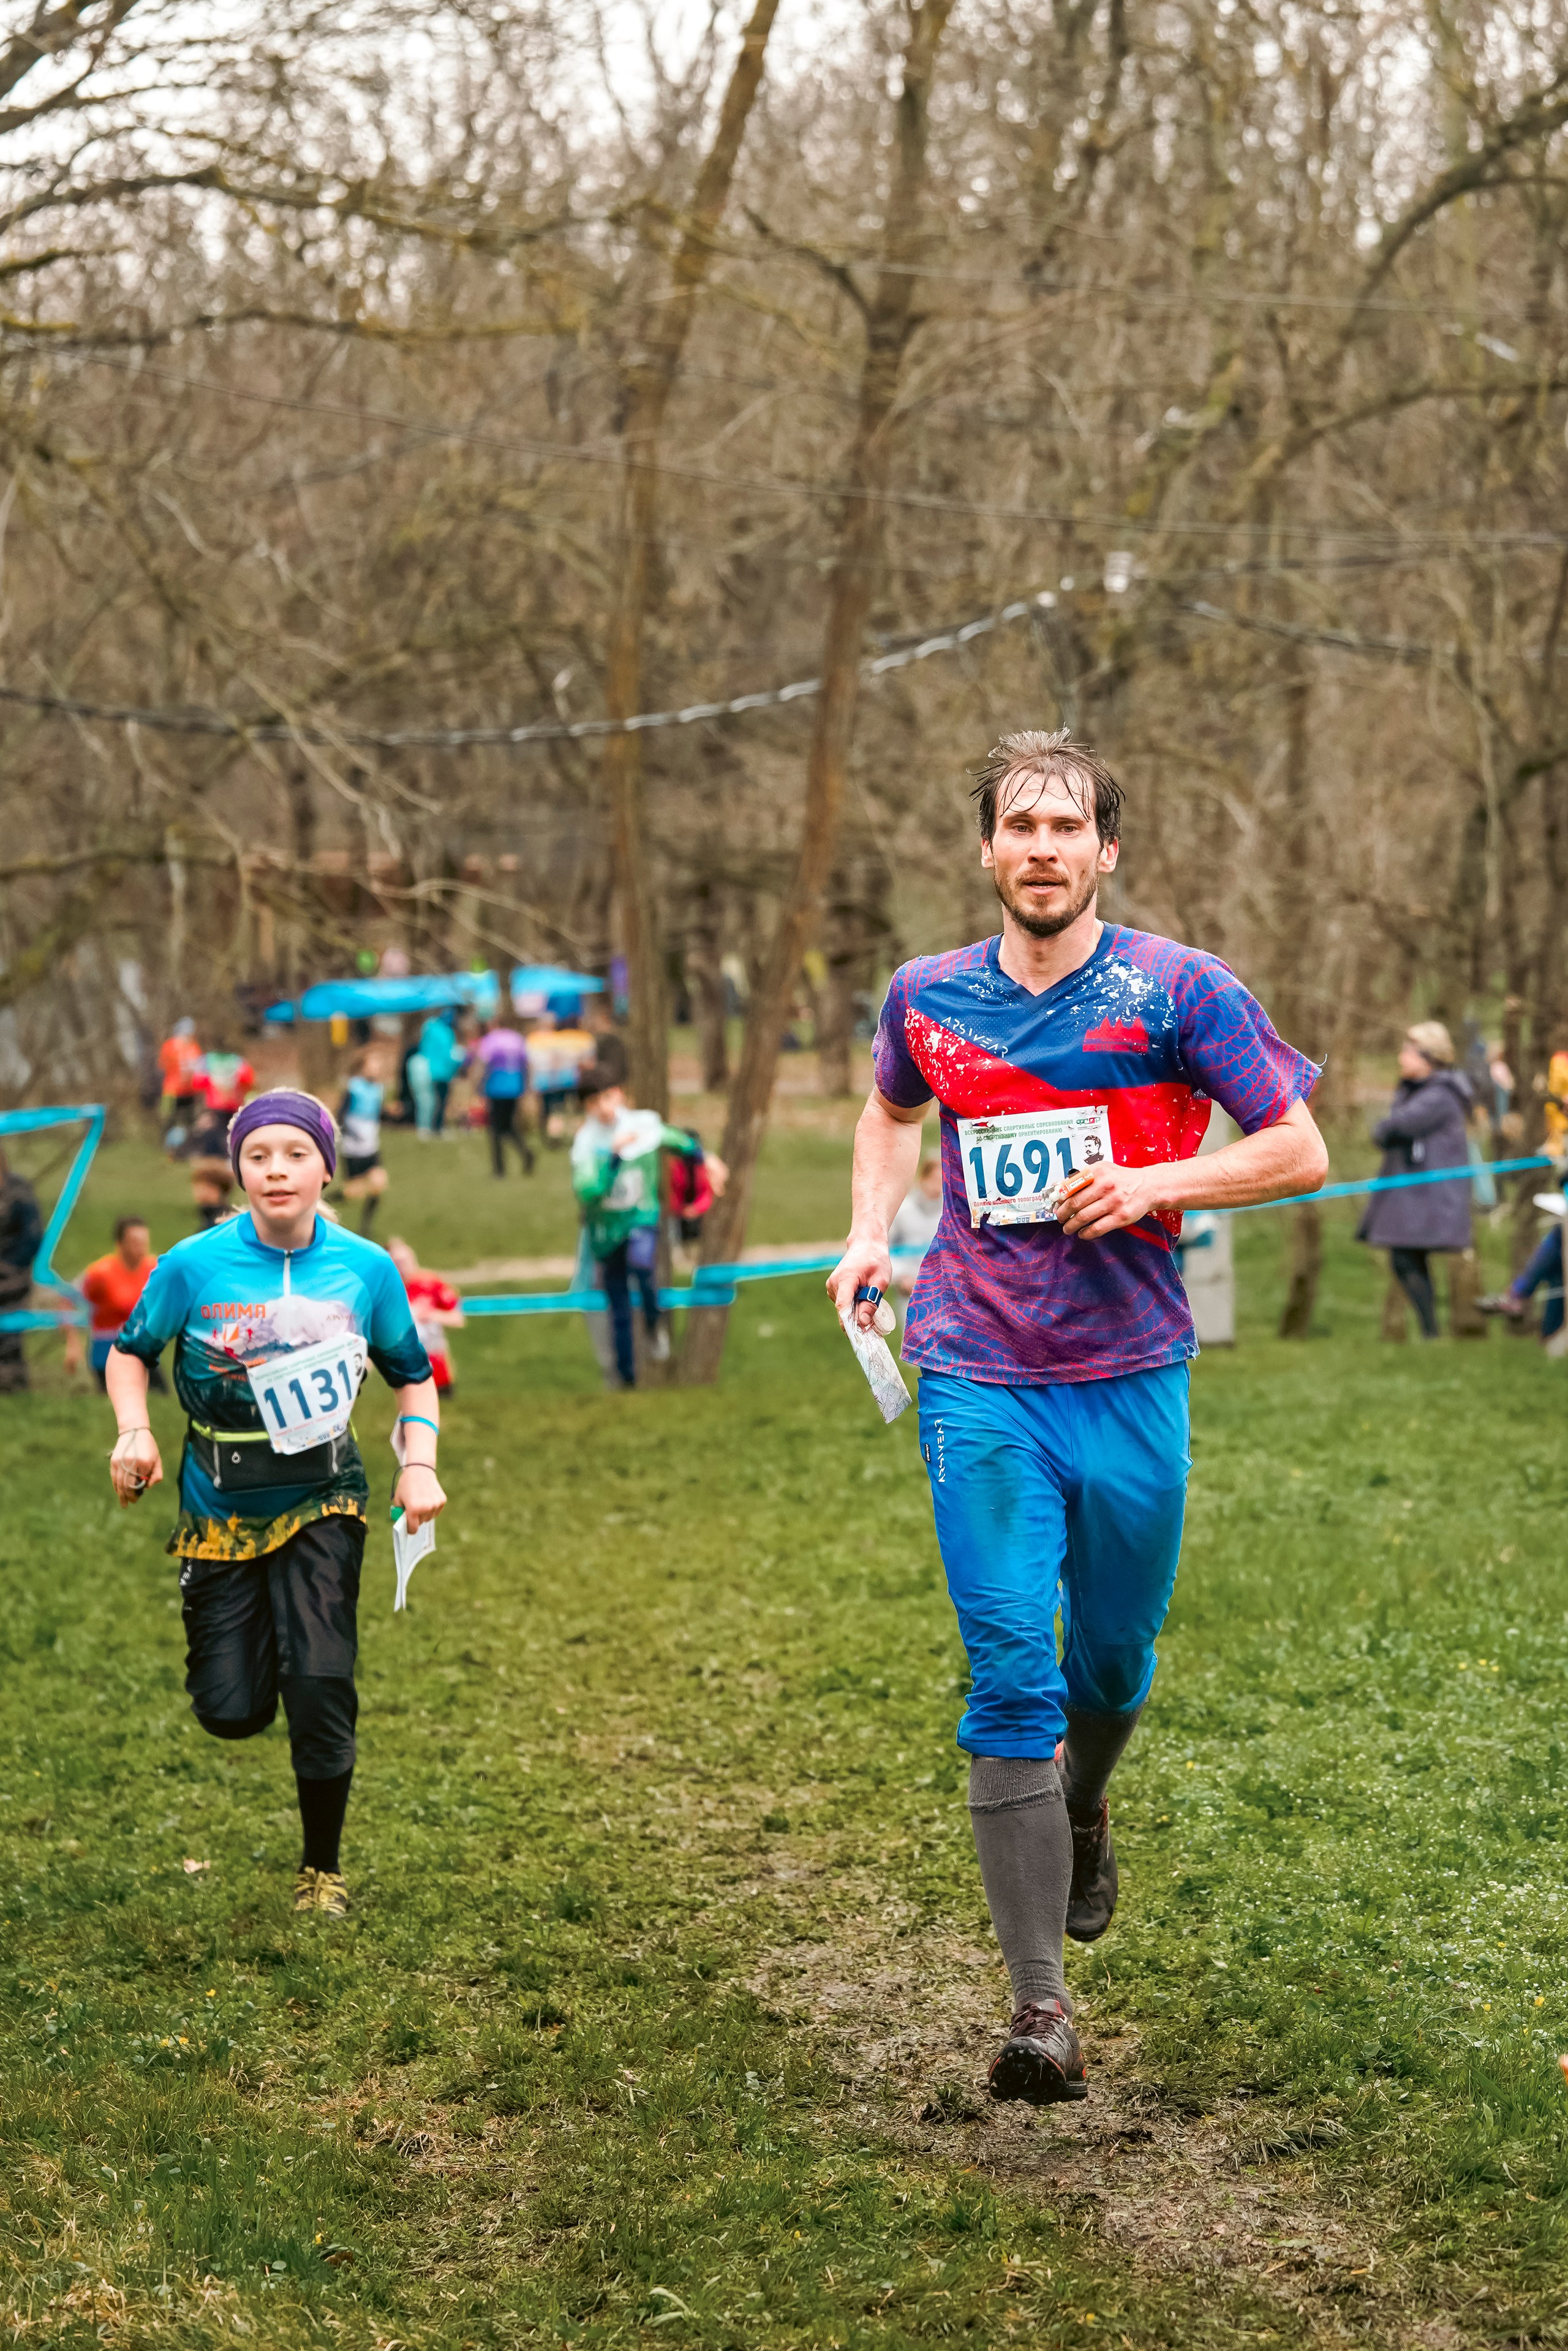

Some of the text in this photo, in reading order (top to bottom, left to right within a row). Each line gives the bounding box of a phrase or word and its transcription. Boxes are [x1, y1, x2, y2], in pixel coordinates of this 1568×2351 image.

[1036, 1120, 1073, 1128] СОРЕВНОВАНИЯ
[1019, 1128, 1062, 1137] ОРИЕНТИРОВАНИЮ
[969, 1138, 1073, 1199] 1691
[1017, 1194, 1042, 1203] топограф
[200, 1302, 266, 1319] ОЛИМП
[263, 1359, 352, 1429] 1131
